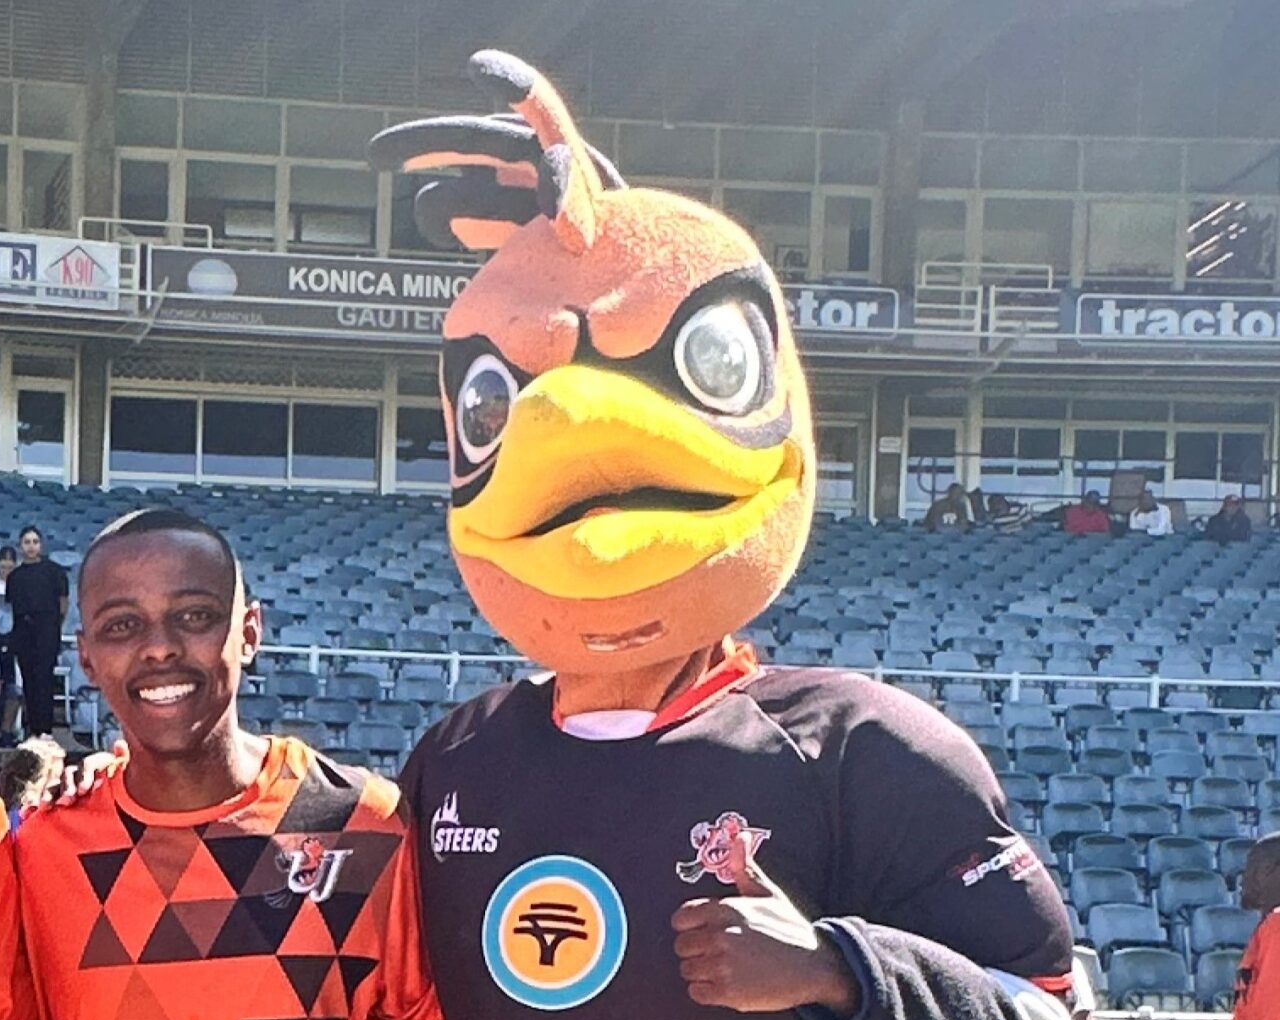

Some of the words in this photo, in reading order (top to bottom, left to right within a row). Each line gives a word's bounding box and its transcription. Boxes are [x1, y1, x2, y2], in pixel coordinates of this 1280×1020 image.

[288, 266, 397, 297] KONICA
[1098, 300, 1280, 337] tracto
[434, 827, 500, 853] STEERS
